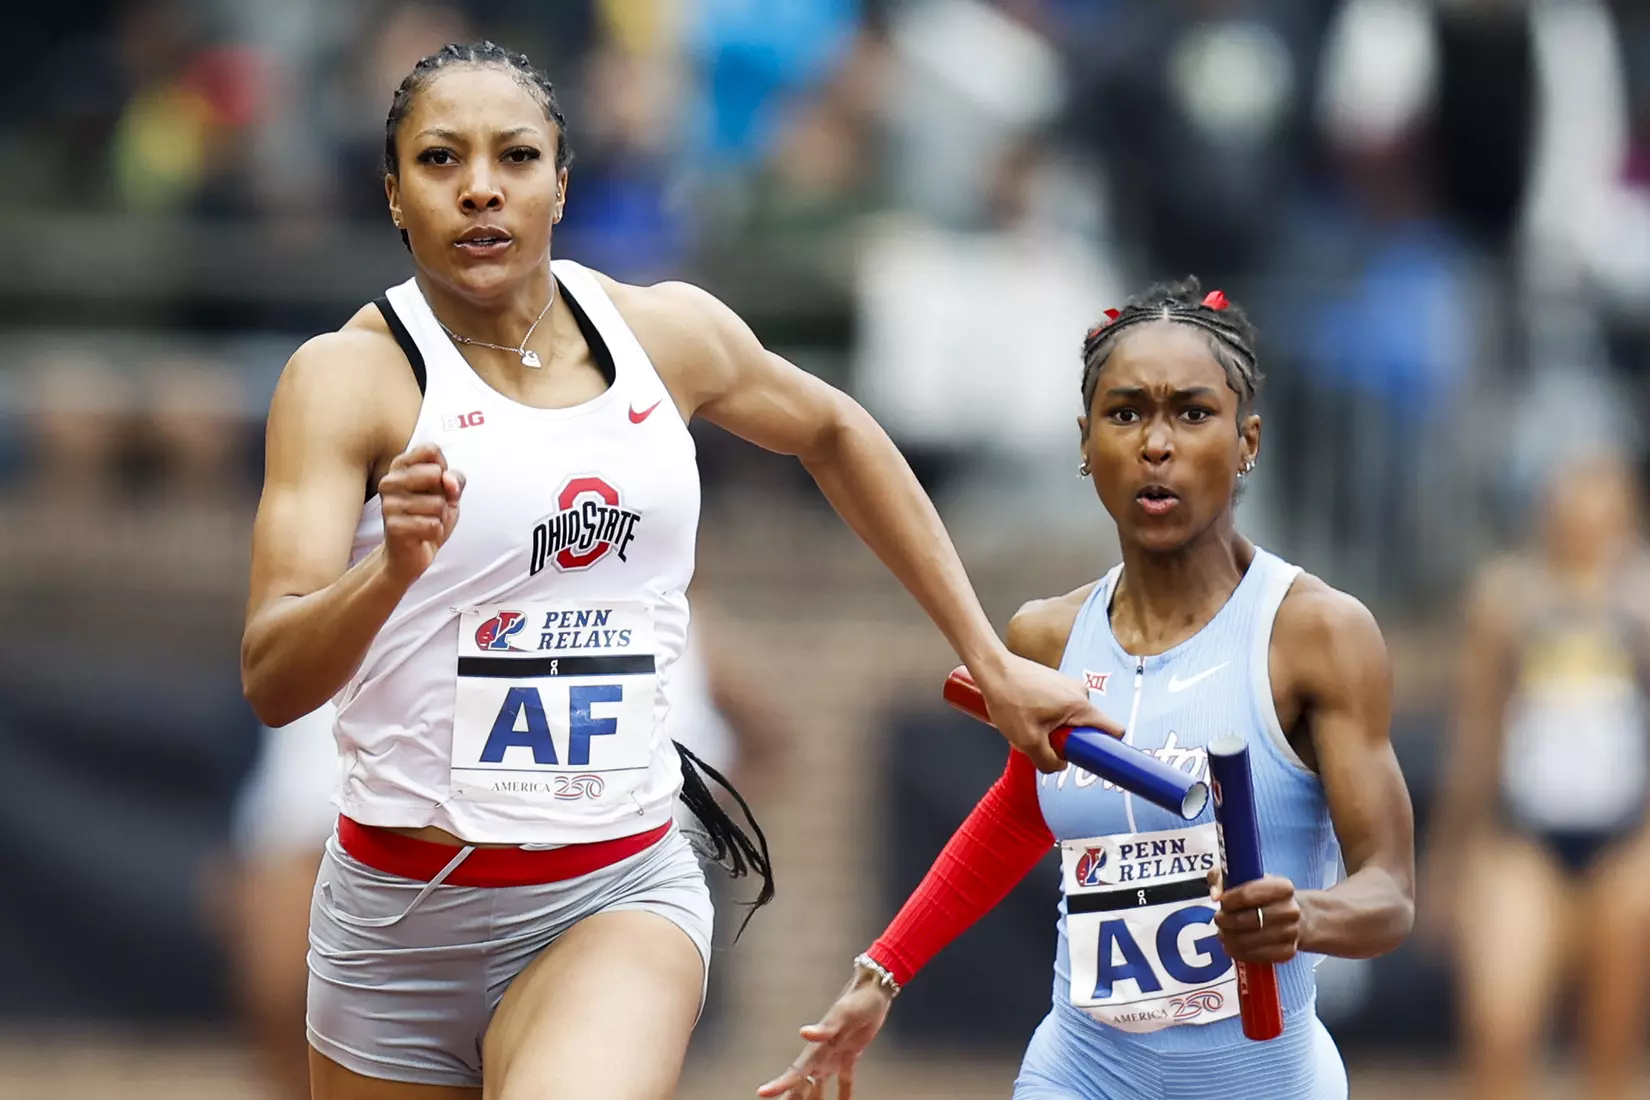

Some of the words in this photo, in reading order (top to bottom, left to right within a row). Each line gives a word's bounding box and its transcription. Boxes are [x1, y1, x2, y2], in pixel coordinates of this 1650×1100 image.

[530, 511, 580, 577] OHIO
[579, 501, 641, 563] STATE
[543, 609, 613, 629] PENN
[537, 629, 632, 650] RELAYS
[479, 685, 623, 766] AF
[491, 781, 551, 793] AMERICA
[554, 774, 604, 800] 250
[1119, 838, 1186, 860] PENN
[1118, 853, 1214, 882] RELAYS
[1091, 905, 1233, 1000] AG
[1113, 1008, 1168, 1024] AMERICA
[1169, 990, 1224, 1022] 250
